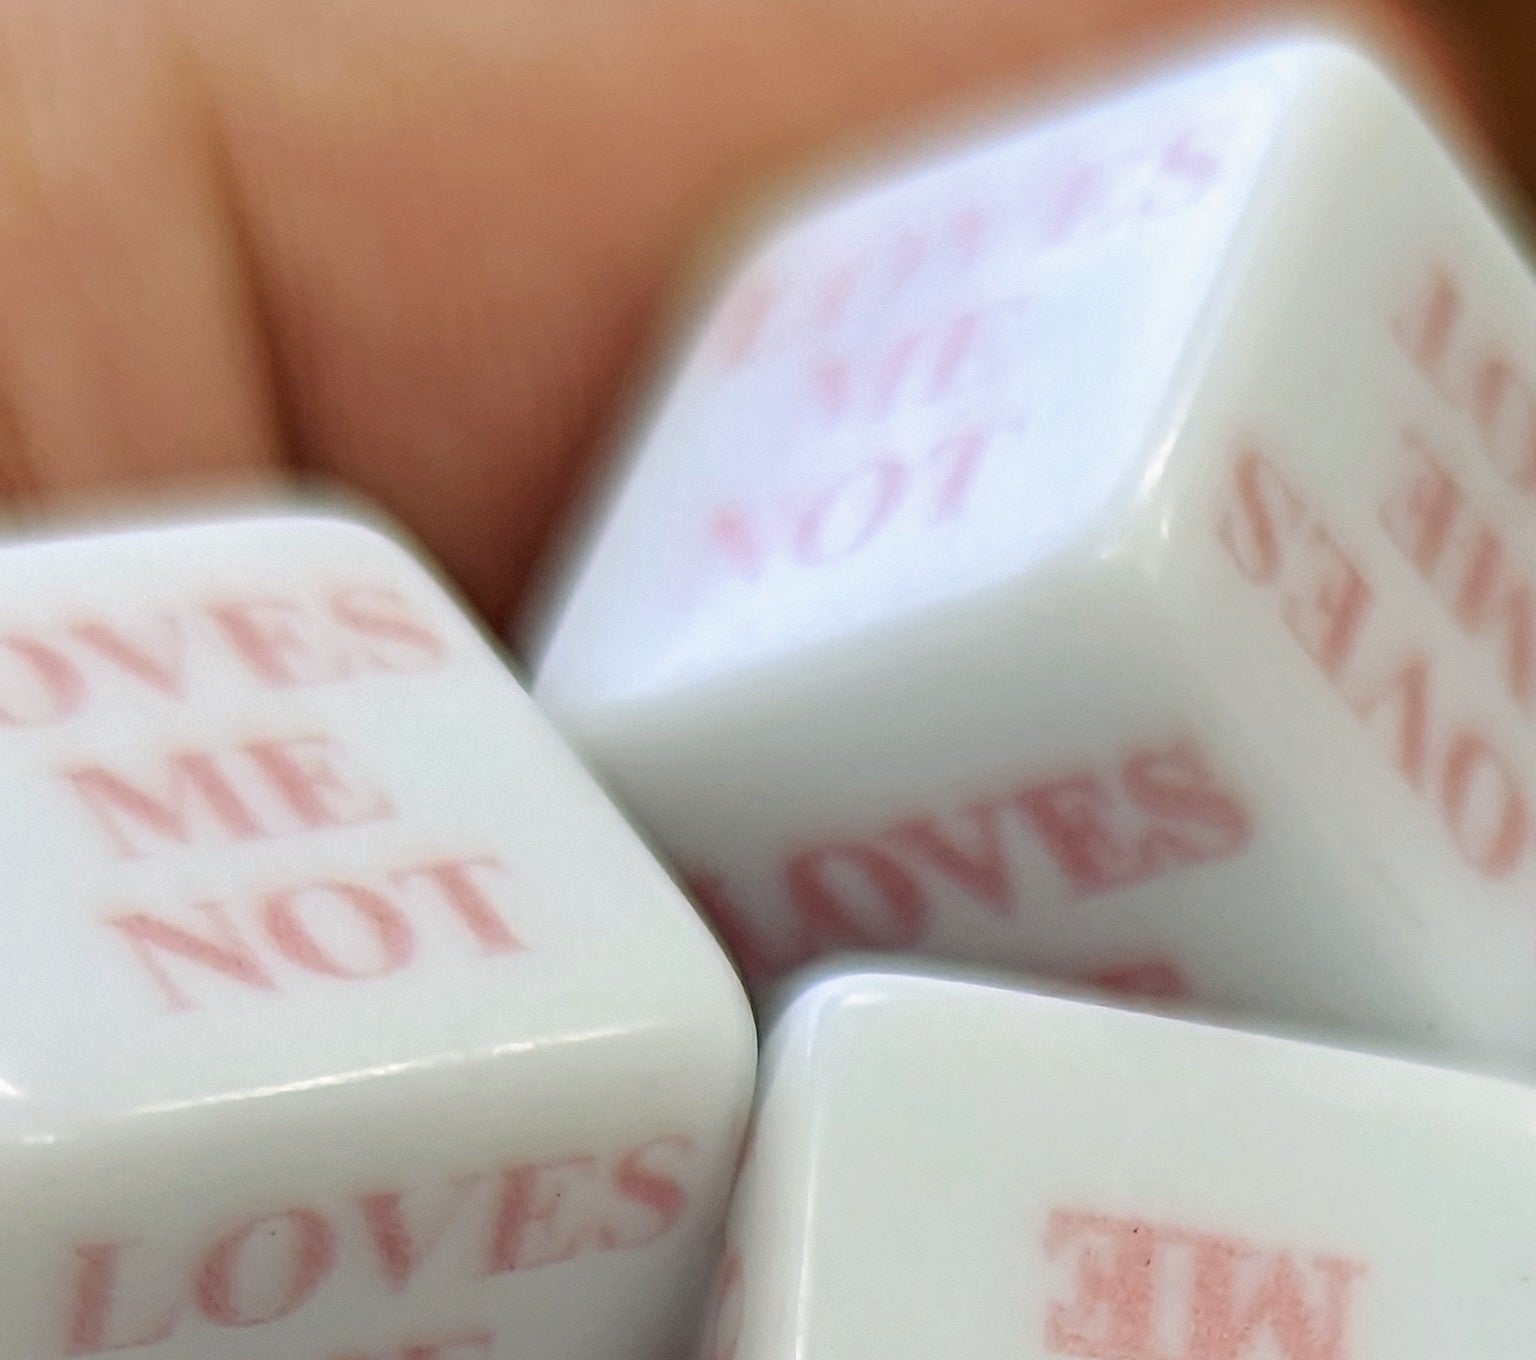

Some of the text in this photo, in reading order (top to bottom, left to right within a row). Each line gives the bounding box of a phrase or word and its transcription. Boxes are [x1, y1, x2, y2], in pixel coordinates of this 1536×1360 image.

[0, 582, 452, 730] OVES
[61, 734, 396, 861] ME
[105, 851, 530, 1013] NOT
[59, 1132, 703, 1360] LOVES
